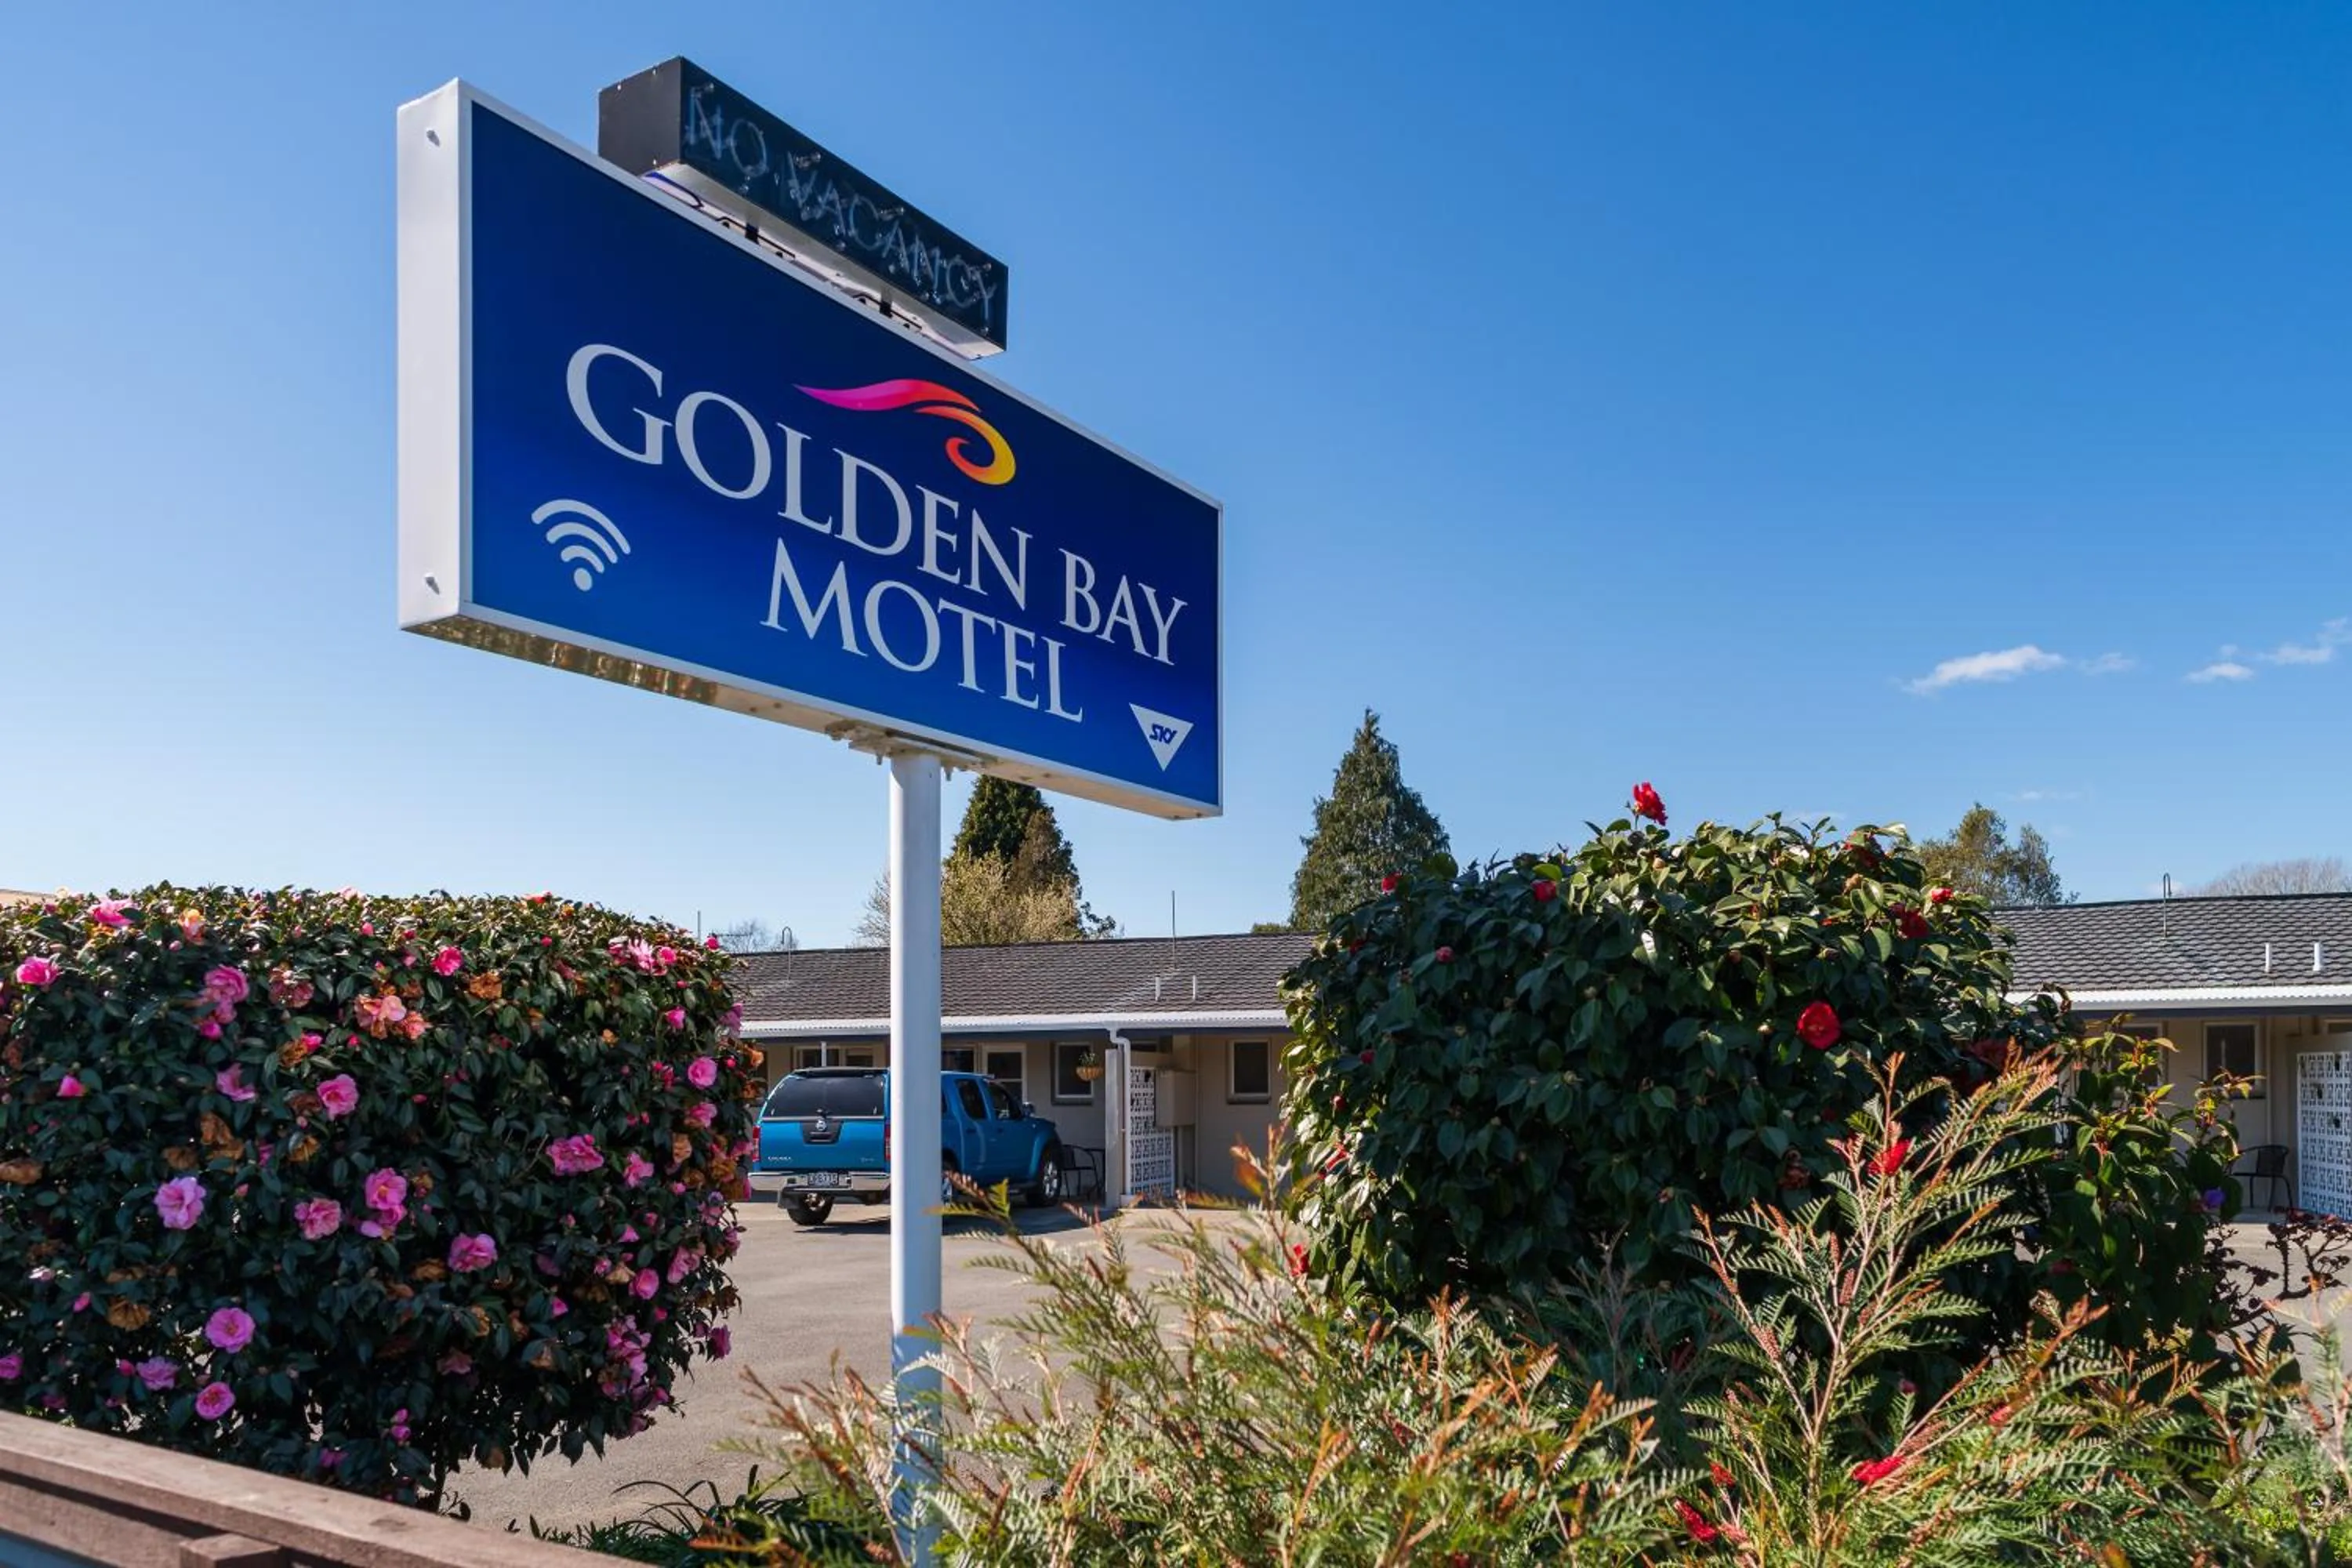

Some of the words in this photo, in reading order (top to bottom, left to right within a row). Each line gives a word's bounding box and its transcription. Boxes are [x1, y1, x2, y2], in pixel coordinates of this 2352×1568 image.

[685, 87, 768, 177] NO
[787, 151, 997, 321] VACANCY
[566, 344, 1033, 612] GOLDEN
[1058, 548, 1188, 666] BAY
[759, 537, 1083, 723] MOTEL
